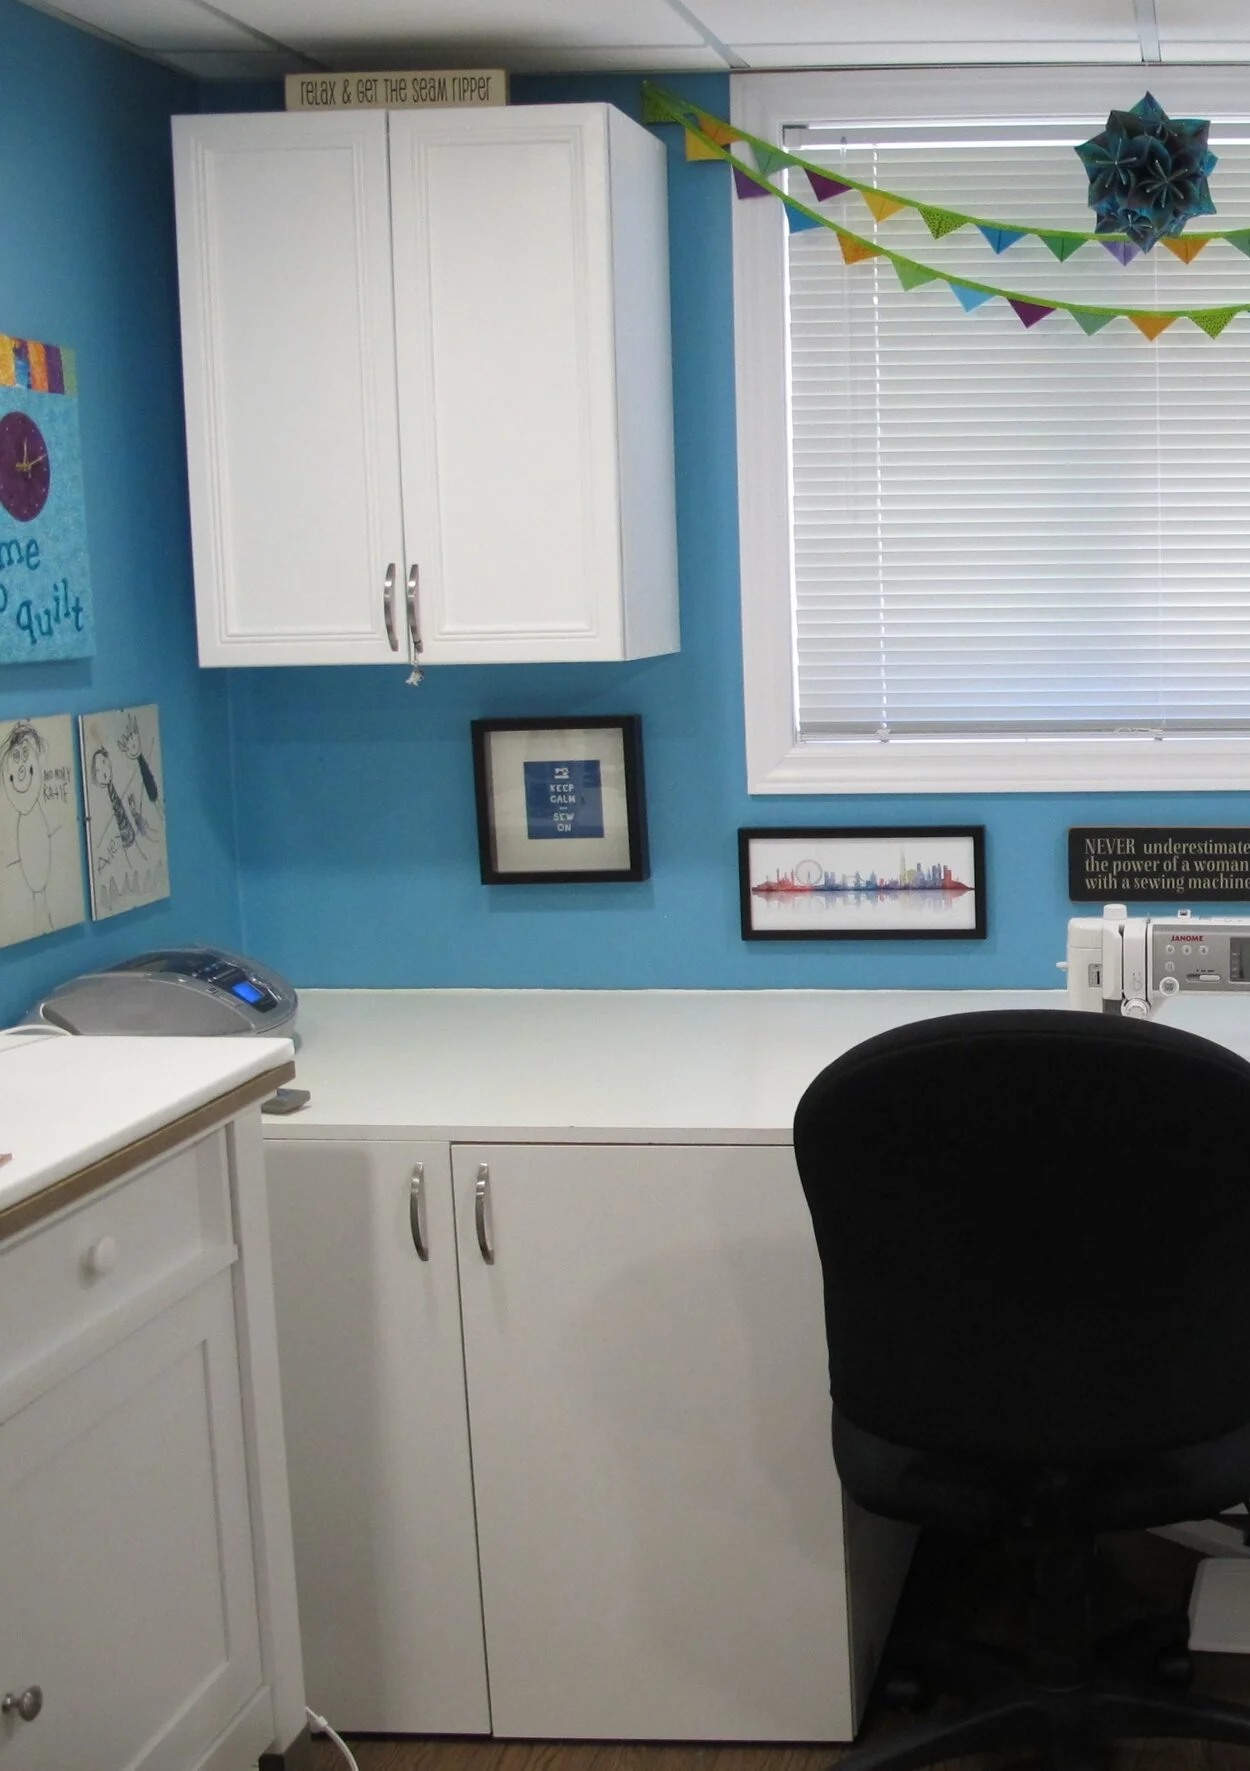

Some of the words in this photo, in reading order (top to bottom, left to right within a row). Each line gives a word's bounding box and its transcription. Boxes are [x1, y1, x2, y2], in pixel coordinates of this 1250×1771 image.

[342, 78, 352, 104] &
[16, 578, 84, 645] quilt
[549, 784, 574, 792] KEEP
[549, 795, 576, 803] CALM
[553, 812, 574, 821] SEW
[557, 823, 571, 832] ON
[1085, 838, 1135, 855] NEVER
[1143, 837, 1250, 855] underestimate
[1085, 855, 1109, 872] the
[1113, 859, 1160, 876] power
[1163, 855, 1179, 872] of
[1181, 859, 1190, 872] a
[1193, 859, 1249, 872] woman
[1085, 873, 1118, 890] with
[1121, 877, 1130, 890] a
[1134, 874, 1185, 894] sewing
